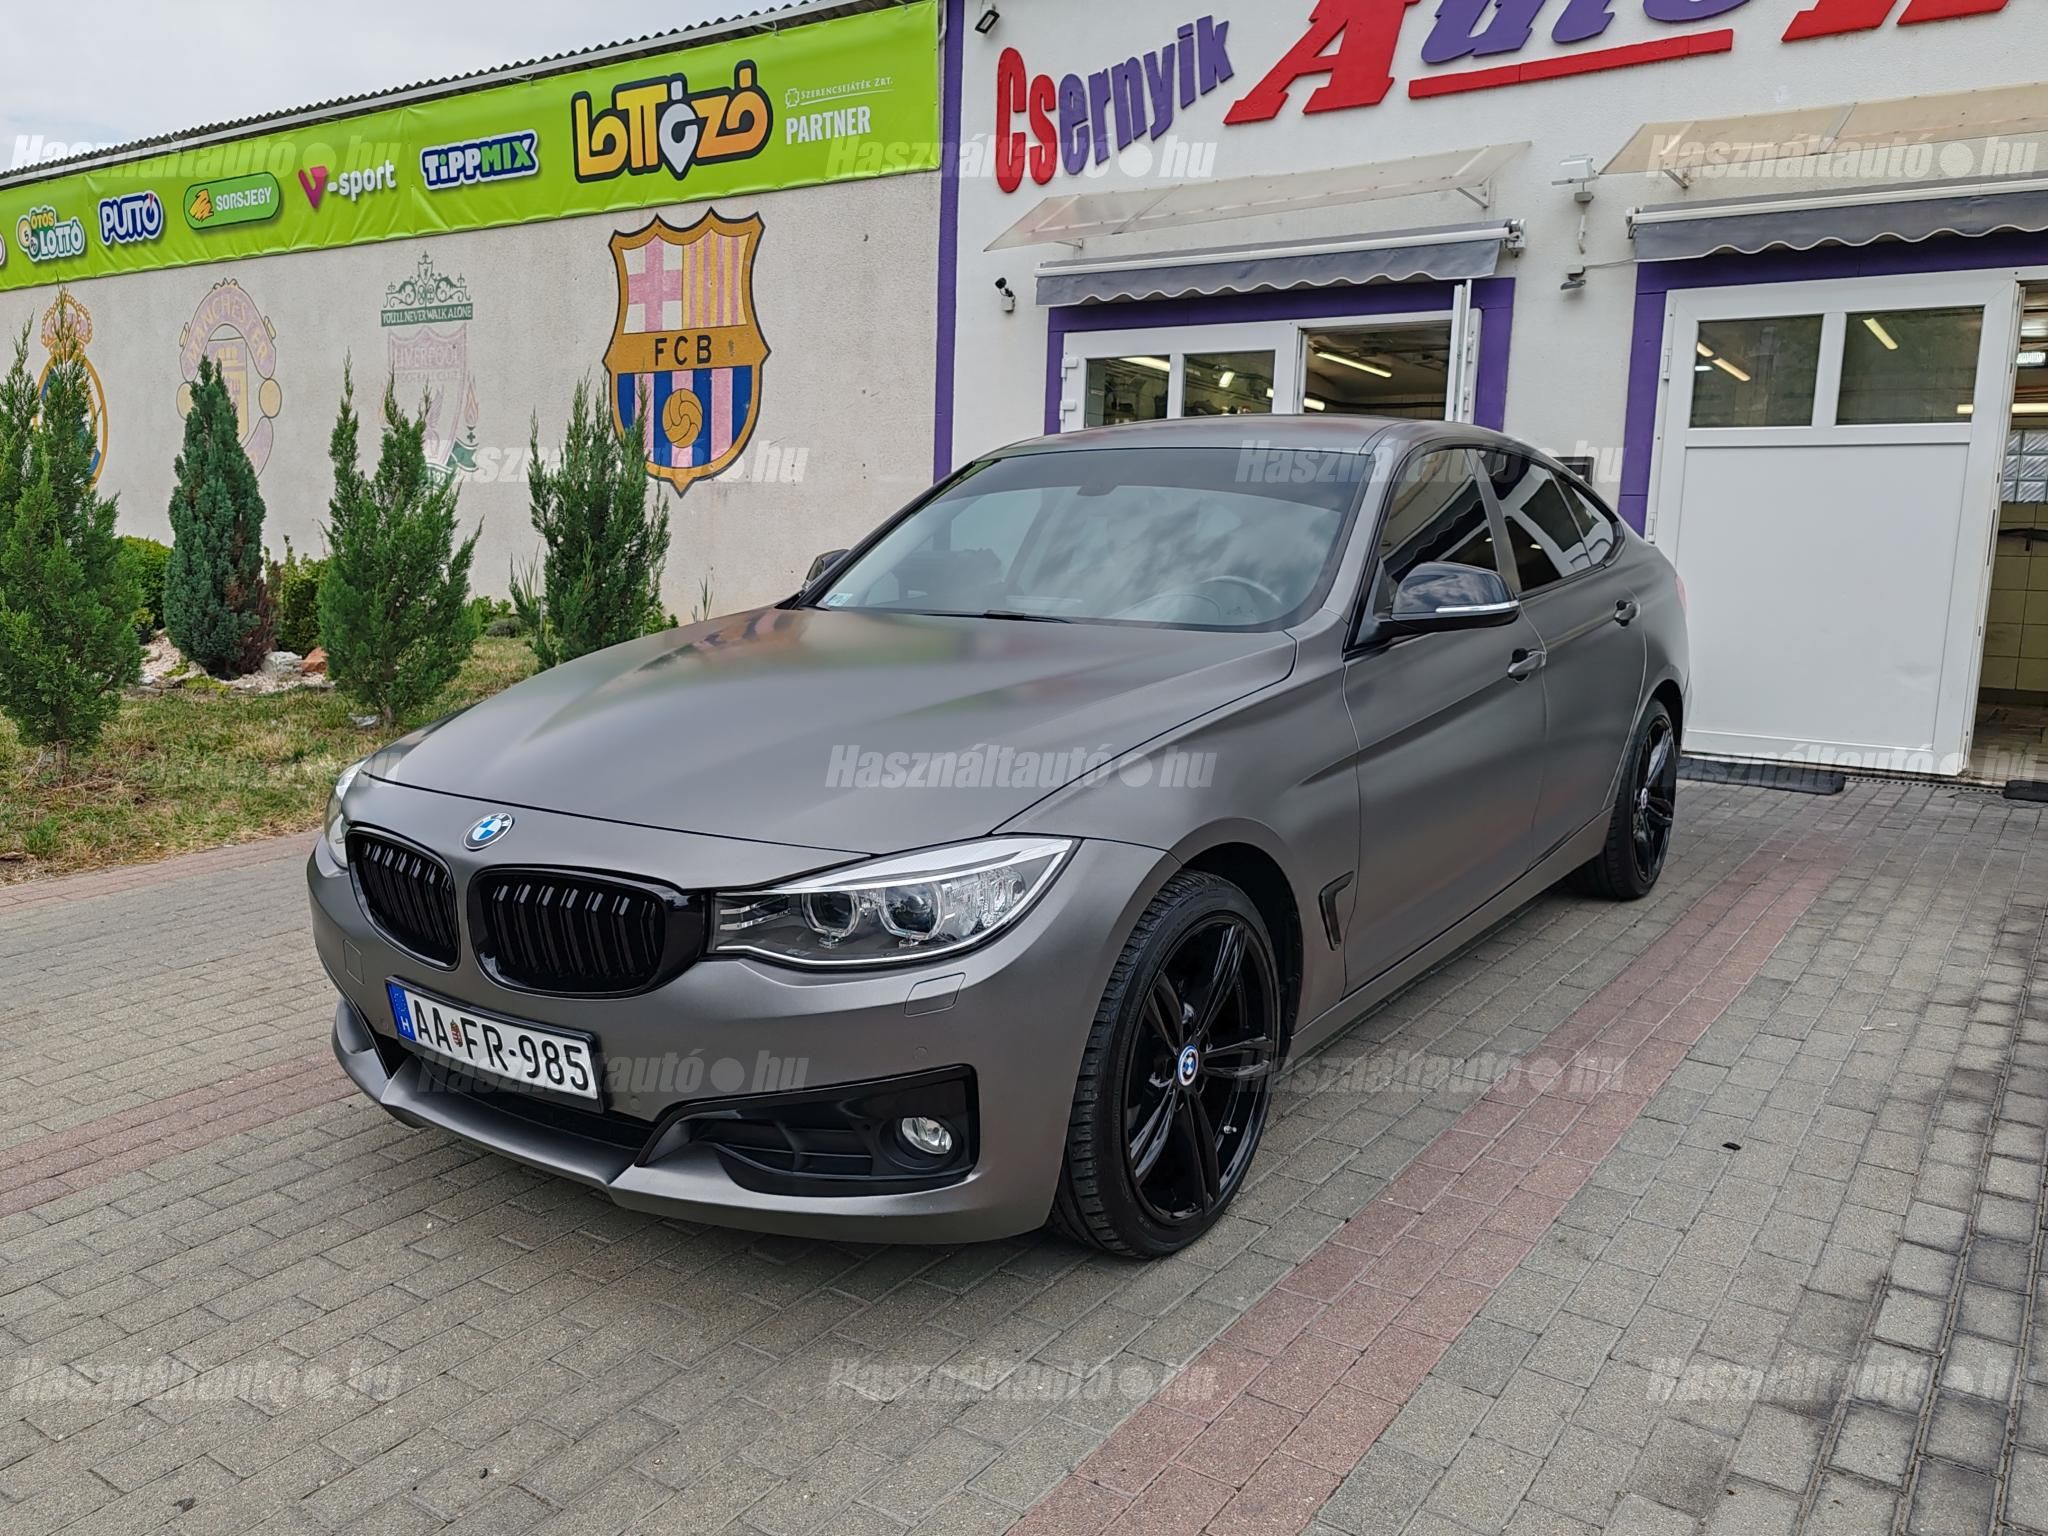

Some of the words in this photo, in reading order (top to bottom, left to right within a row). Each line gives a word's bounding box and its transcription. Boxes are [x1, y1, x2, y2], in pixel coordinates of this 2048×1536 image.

[995, 15, 1235, 194] Csernyik
[785, 106, 871, 145] PARTNER
[216, 187, 272, 211] SORSJEGY
[298, 159, 397, 209] V-sport
[404, 309, 426, 323] NEVER
[426, 308, 448, 320] WALK
[447, 305, 472, 319] ALONE
[400, 1016, 411, 1033] H
